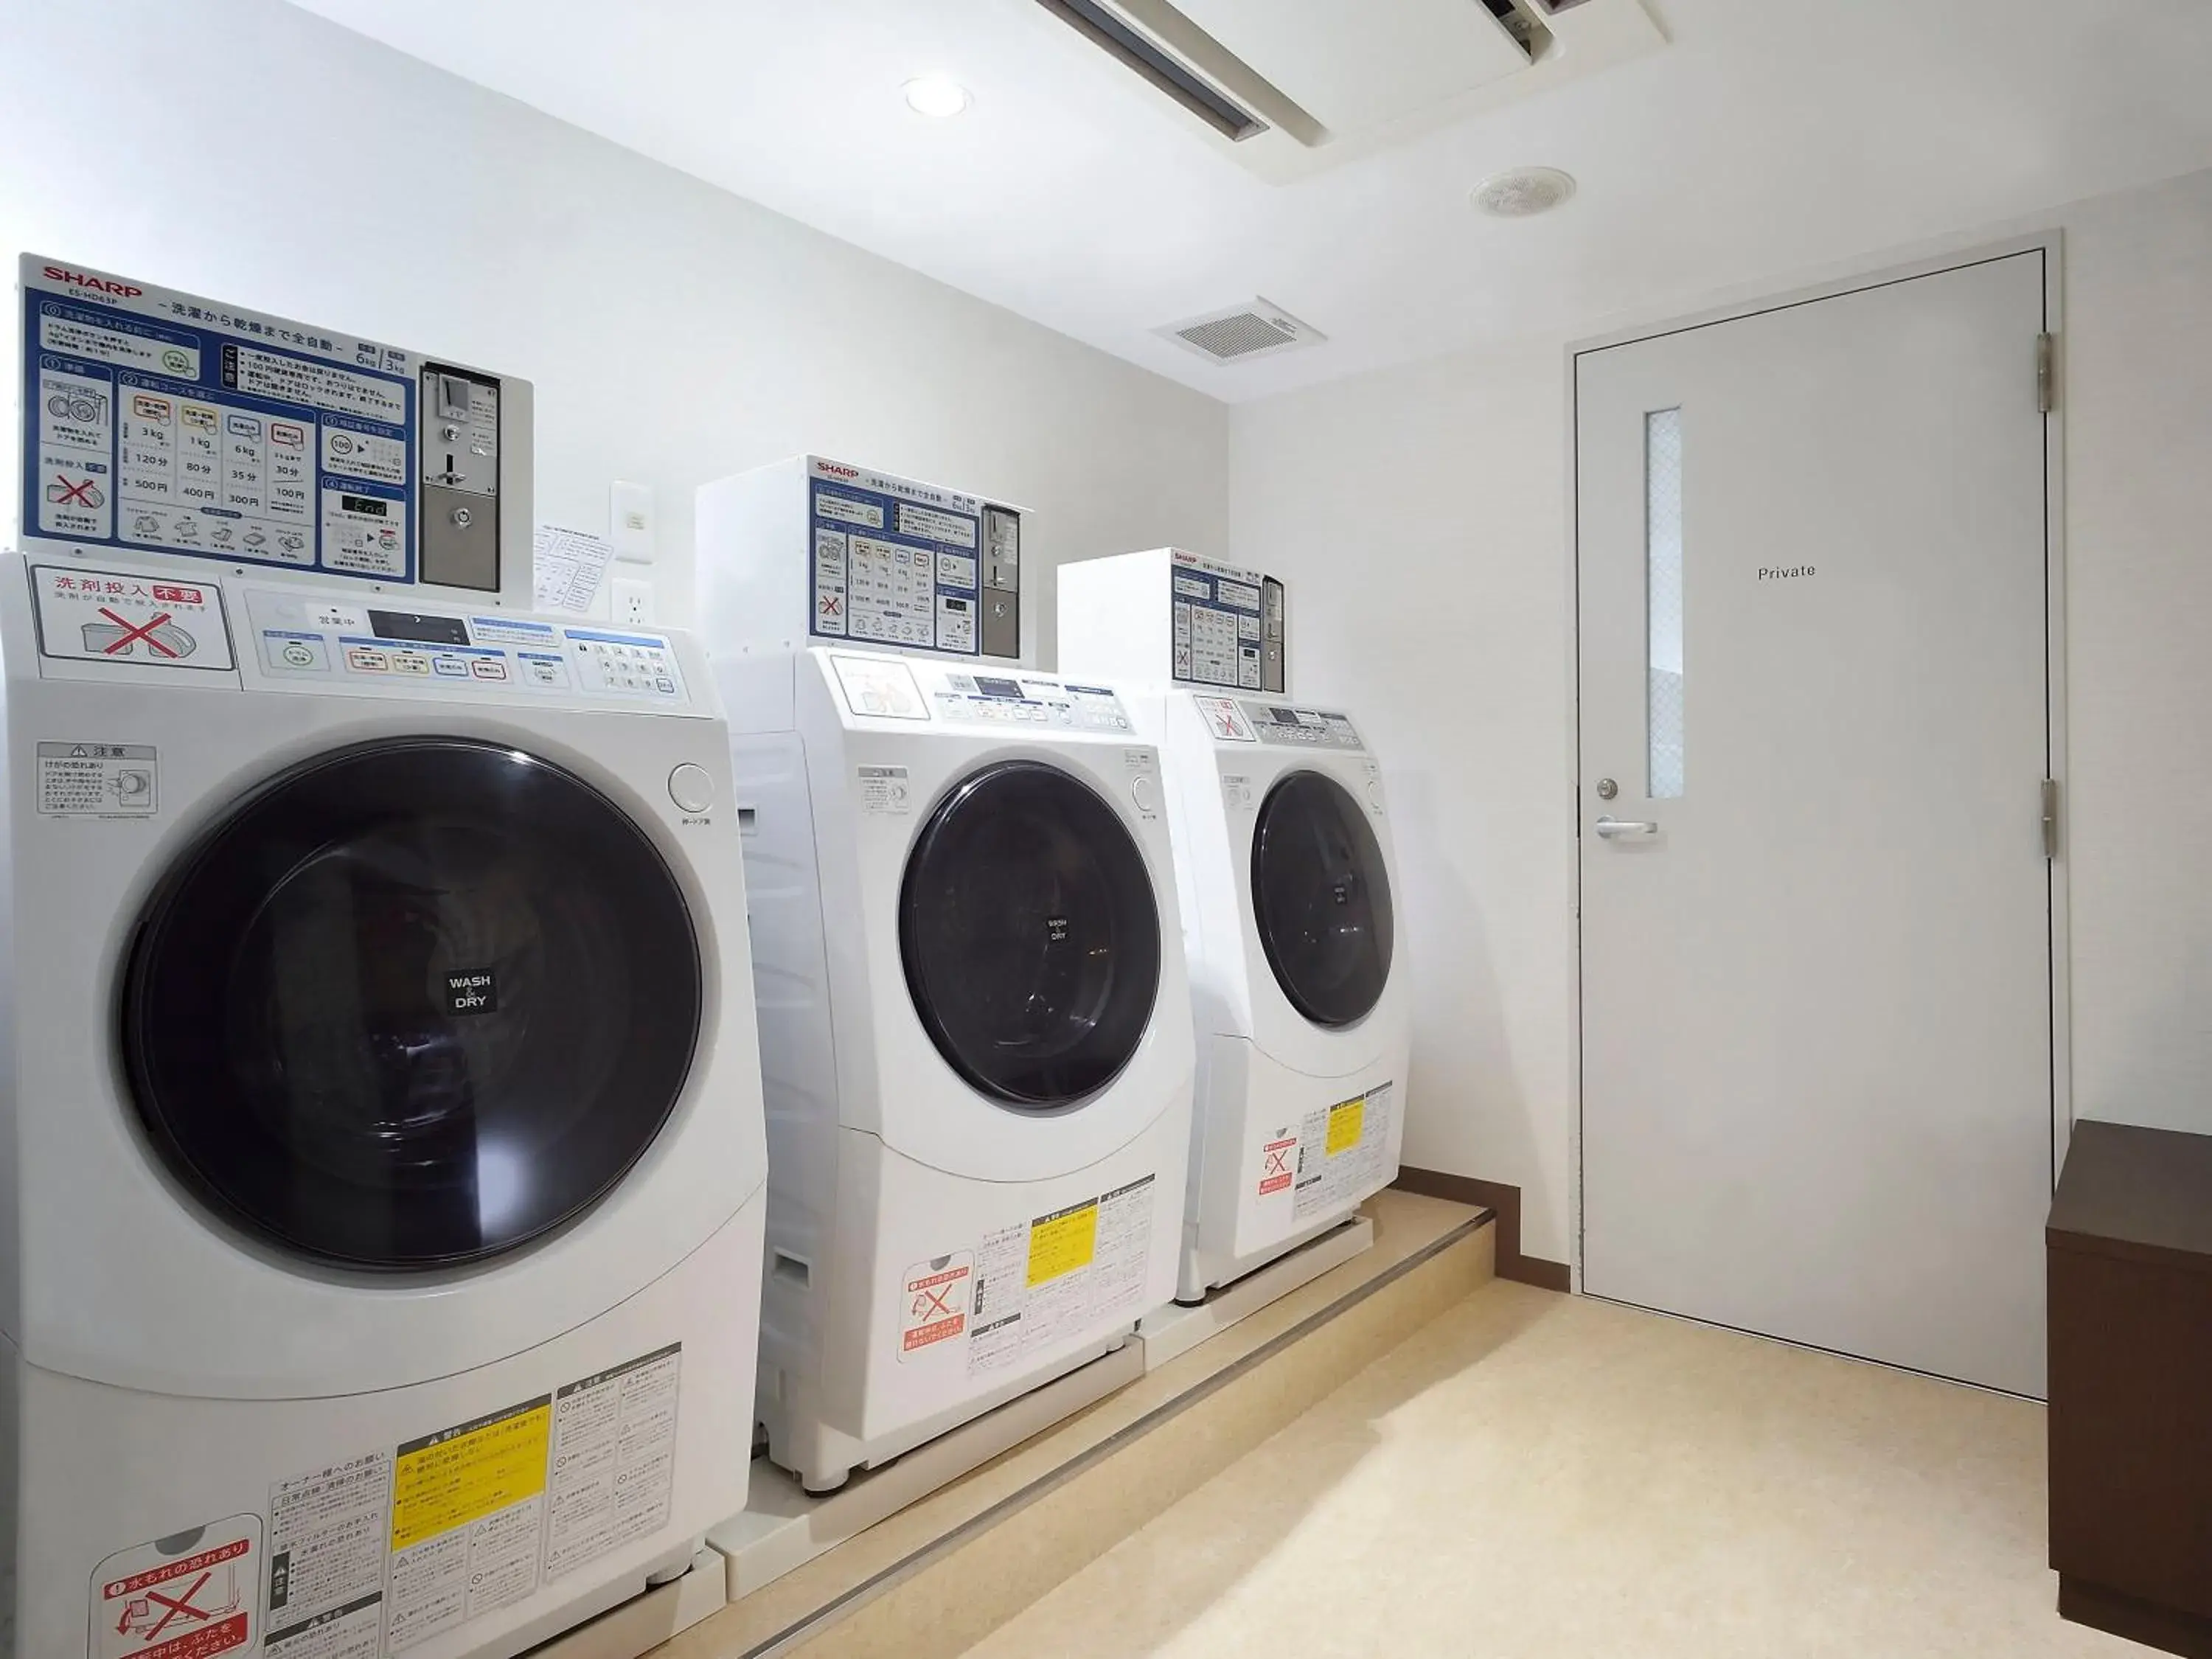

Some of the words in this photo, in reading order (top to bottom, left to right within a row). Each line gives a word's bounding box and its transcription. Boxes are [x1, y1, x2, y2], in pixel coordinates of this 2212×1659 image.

[43, 266, 142, 298] SHARP
[817, 461, 859, 478] SHARP
[1758, 566, 1816, 580] Private
[54, 576, 149, 597] 洗剤投入
[449, 975, 490, 989] WASH
[455, 996, 487, 1008] DRY
[128, 1543, 244, 1587] 水もれの恐れあり
